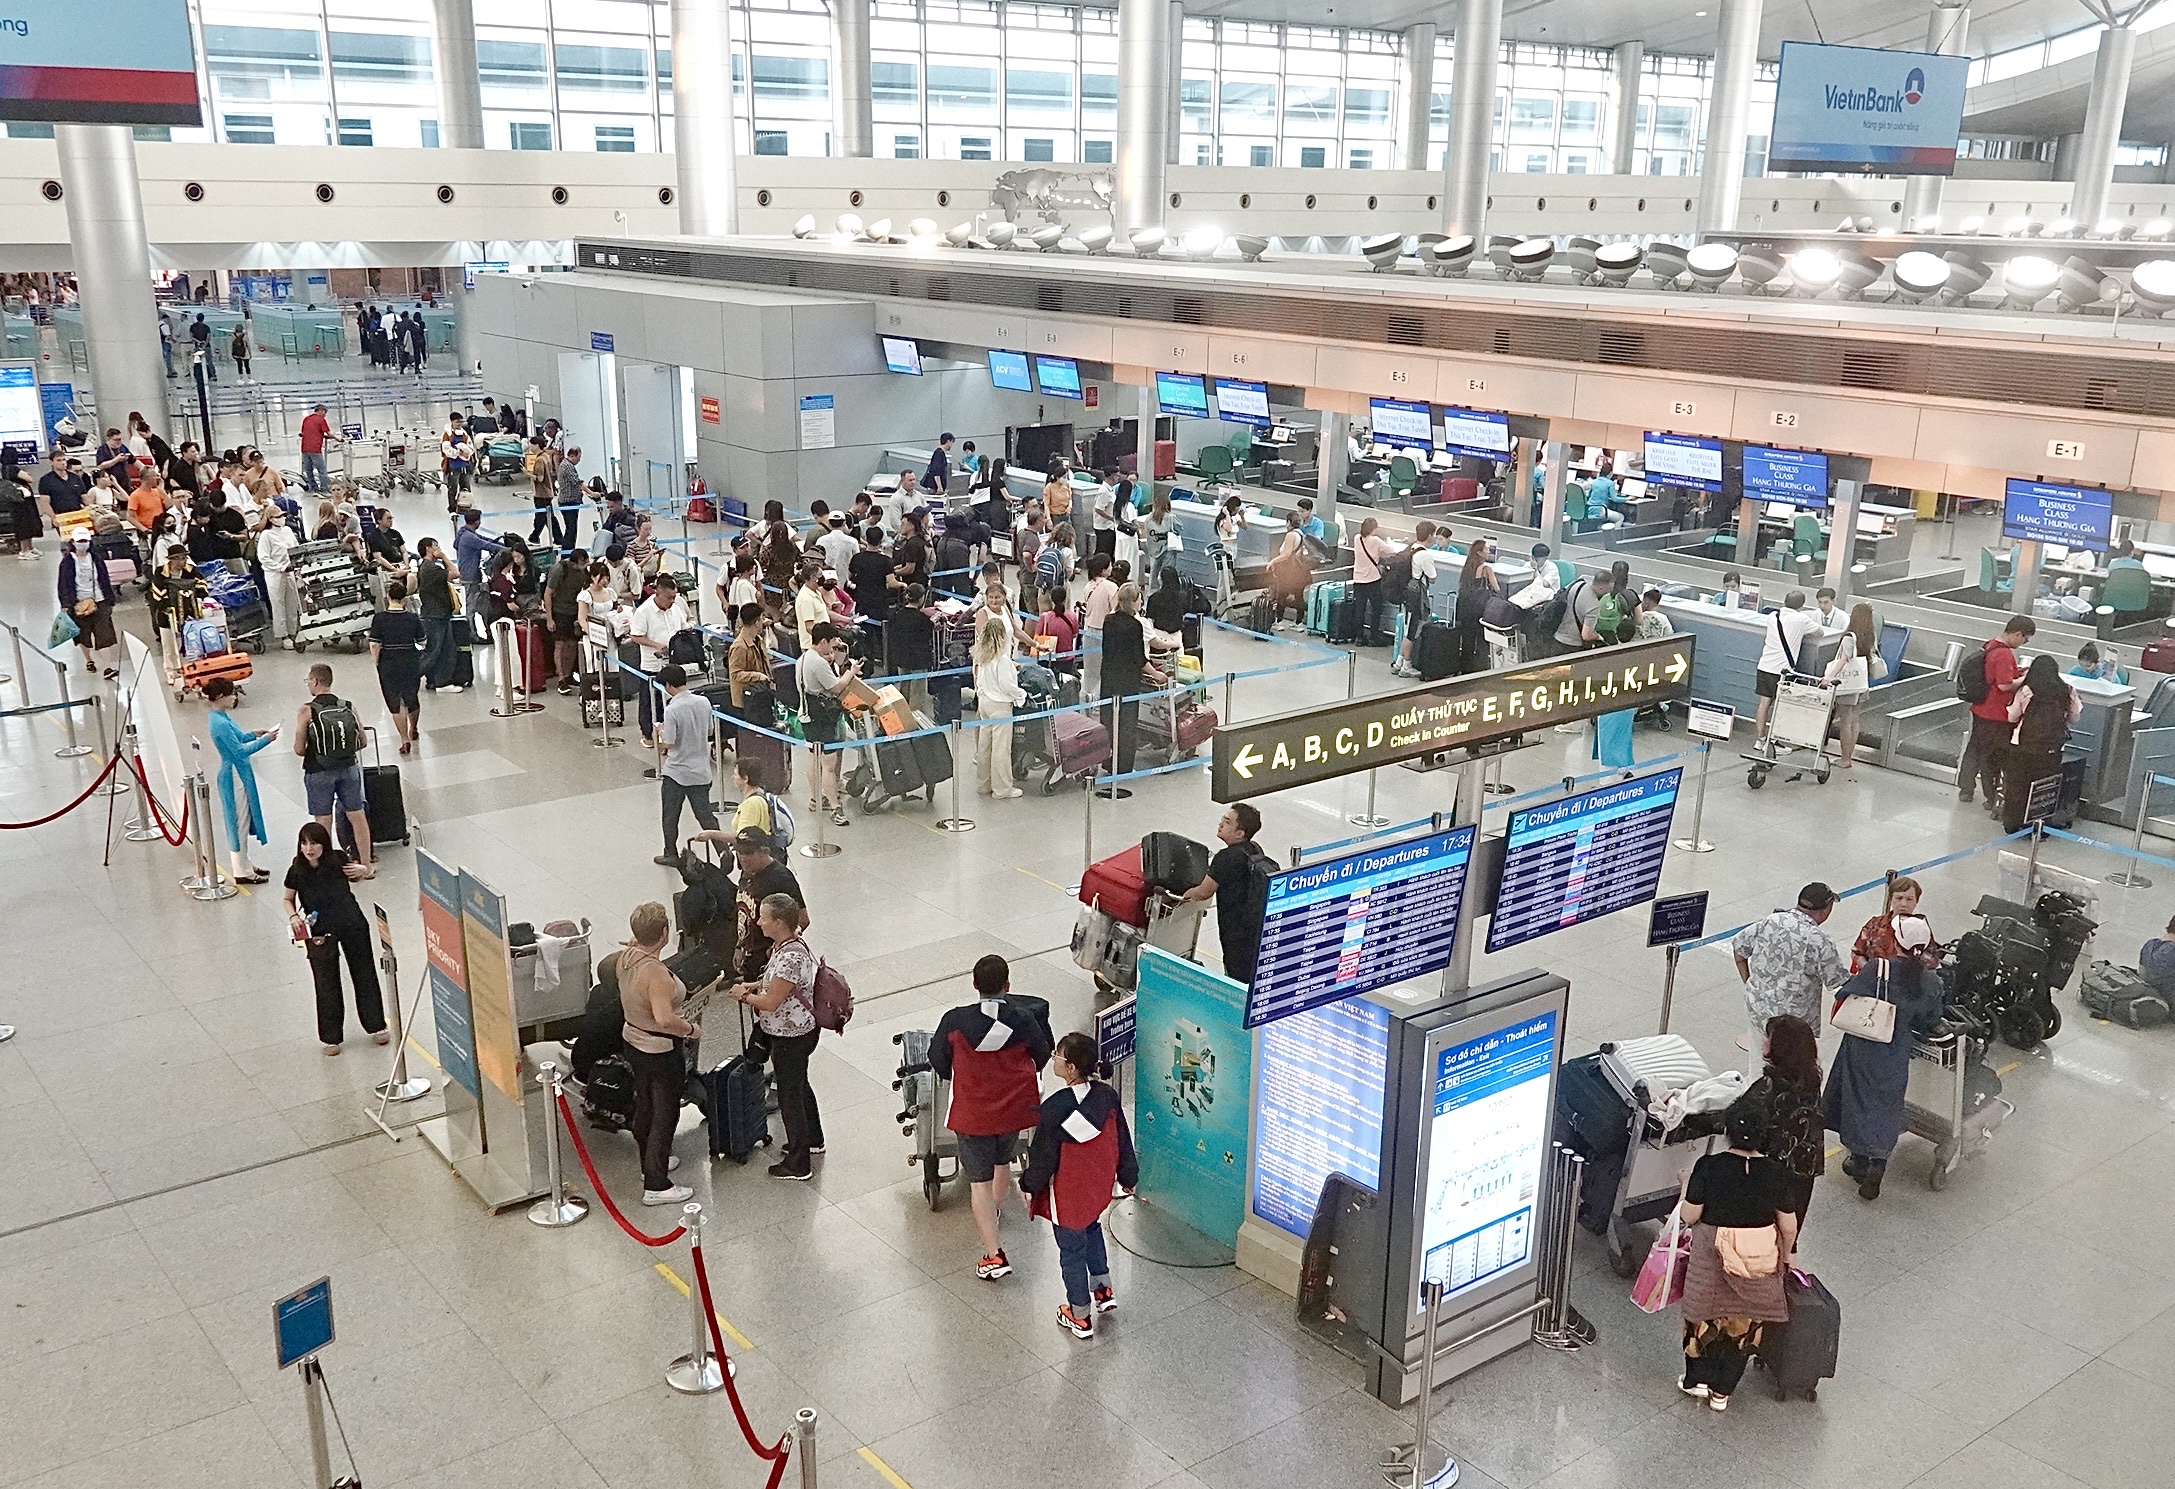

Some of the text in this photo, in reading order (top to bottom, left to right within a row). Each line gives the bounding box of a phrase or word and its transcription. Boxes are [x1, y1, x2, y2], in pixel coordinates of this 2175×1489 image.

[0, 19, 28, 36] ng
[1825, 84, 1905, 113] VietinBank
[1174, 348, 1184, 357] E-7
[1234, 355, 1245, 364] E-6
[1393, 372, 1406, 382] E-5
[1470, 380, 1484, 390] E-4
[1675, 403, 1693, 414] E-3
[1776, 414, 1795, 425] E-2
[2055, 444, 2077, 457] E-1
[1769, 462, 1799, 473] BUSINESS
[1774, 471, 1794, 481] CLASS
[1803, 484, 1816, 492] GIA
[2039, 499, 2076, 511] BUSINESS
[2044, 509, 2069, 519] CLASS
[2080, 524, 2096, 533] GIA
[1482, 662, 1659, 723] E, F, G, H, I, J, K, L
[1390, 699, 1478, 730] QUẦY THỦ TỤC
[1390, 730, 1419, 748] Check
[1433, 721, 1470, 740] Counter
[1272, 721, 1383, 771] A, B, C, D
[1652, 774, 1679, 792] 17:34
[1527, 783, 1644, 829] Chuyến đi / Departures
[1441, 832, 1471, 852] 17:34
[1288, 843, 1430, 894] Chuyến đi / Departures
[426, 926, 440, 946] SKY
[427, 940, 461, 975] PRIORITY
[1360, 1009, 1374, 1020] NAM
[1445, 1054, 1456, 1066] Sơ
[1458, 1048, 1469, 1061] đồ
[1470, 1043, 1484, 1057] chỉ
[1484, 1038, 1499, 1051] dẫn
[1506, 1030, 1527, 1043] Thoát
[1529, 1021, 1547, 1035] hiểm
[1444, 1059, 1475, 1074] Information
[1479, 1053, 1490, 1062] Exit
